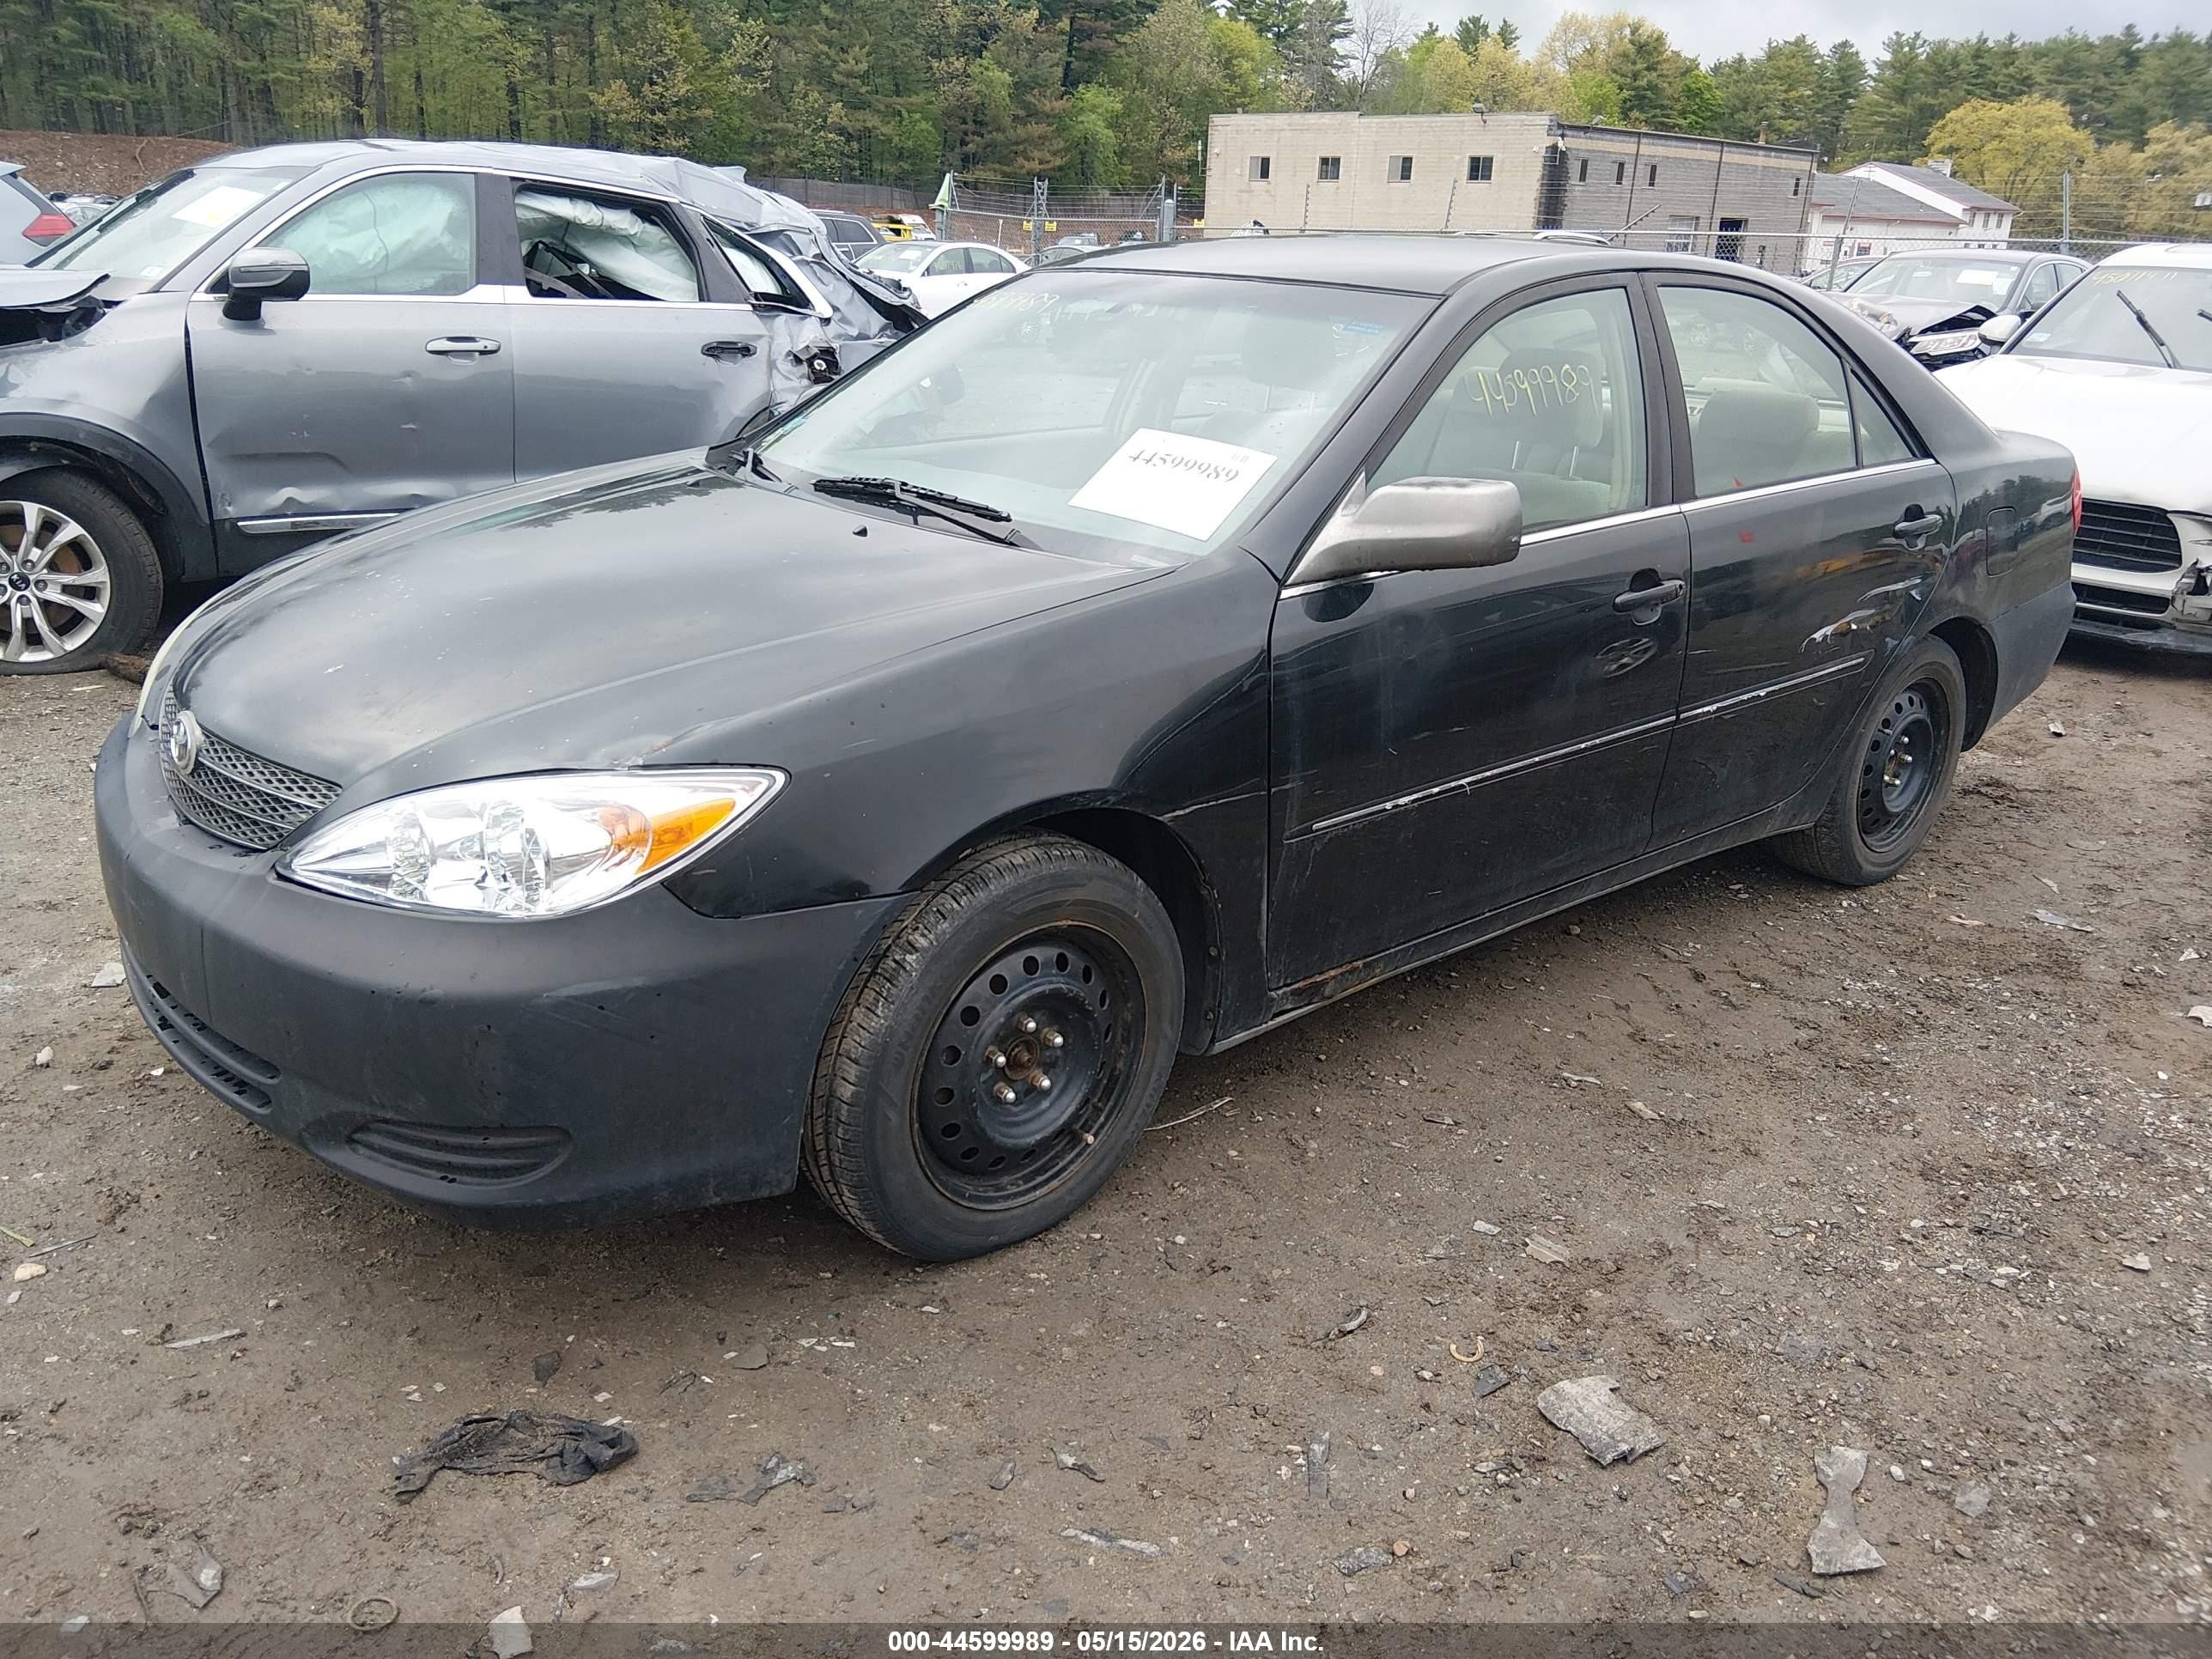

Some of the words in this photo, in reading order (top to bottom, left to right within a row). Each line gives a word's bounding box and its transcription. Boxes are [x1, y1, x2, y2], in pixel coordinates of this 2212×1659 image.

[1463, 363, 1600, 416] 44599989
[1128, 449, 1239, 483] 44599989
[10, 574, 26, 590] KIA
